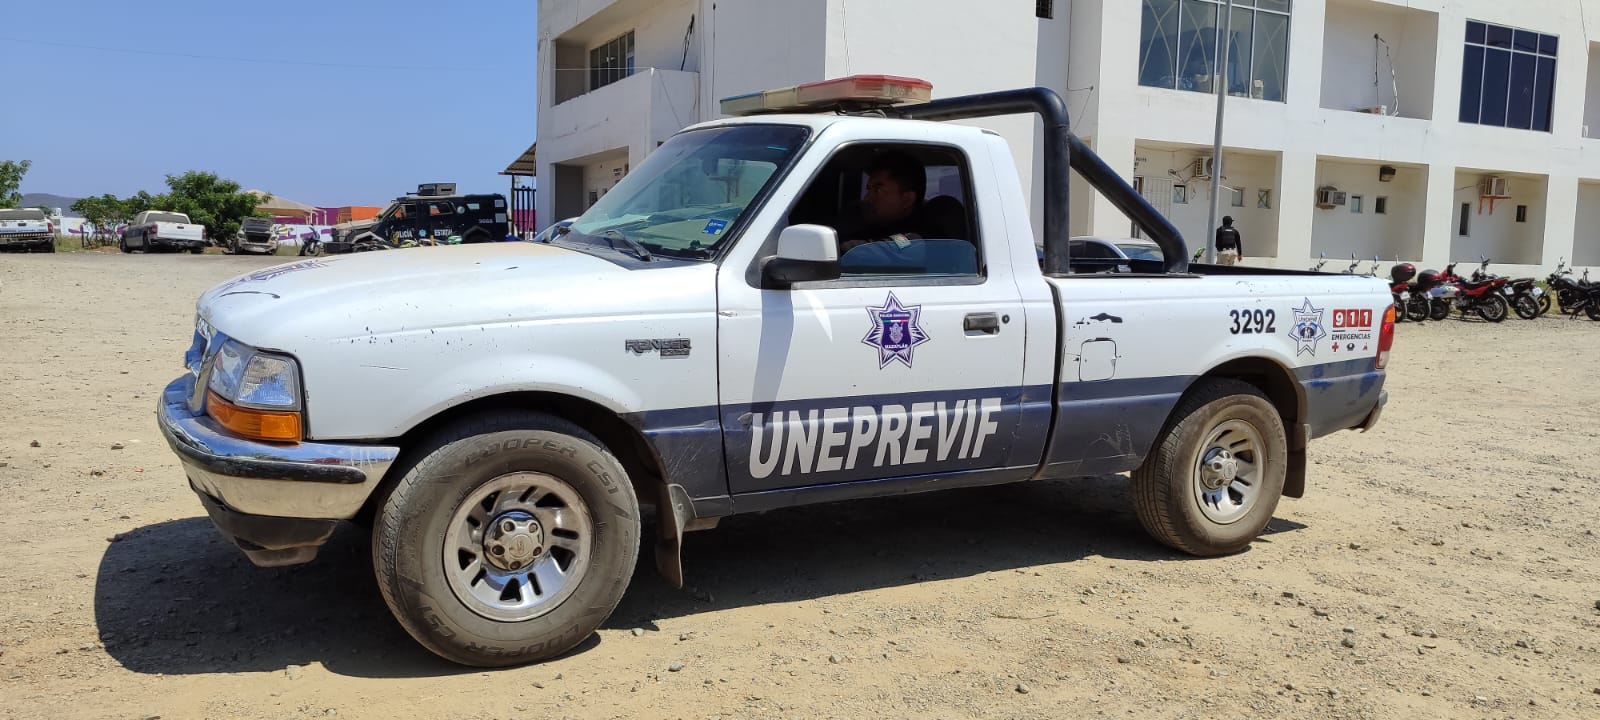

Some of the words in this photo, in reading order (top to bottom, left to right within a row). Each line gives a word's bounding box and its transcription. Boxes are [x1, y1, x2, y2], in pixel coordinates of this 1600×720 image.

[1229, 309, 1276, 335] 3292
[1335, 311, 1369, 326] 911
[1331, 333, 1371, 341] EMERGENCIAS
[749, 397, 1002, 479] UNEPREVIF
[464, 438, 577, 466] COOPER
[465, 624, 580, 657] COOPER
